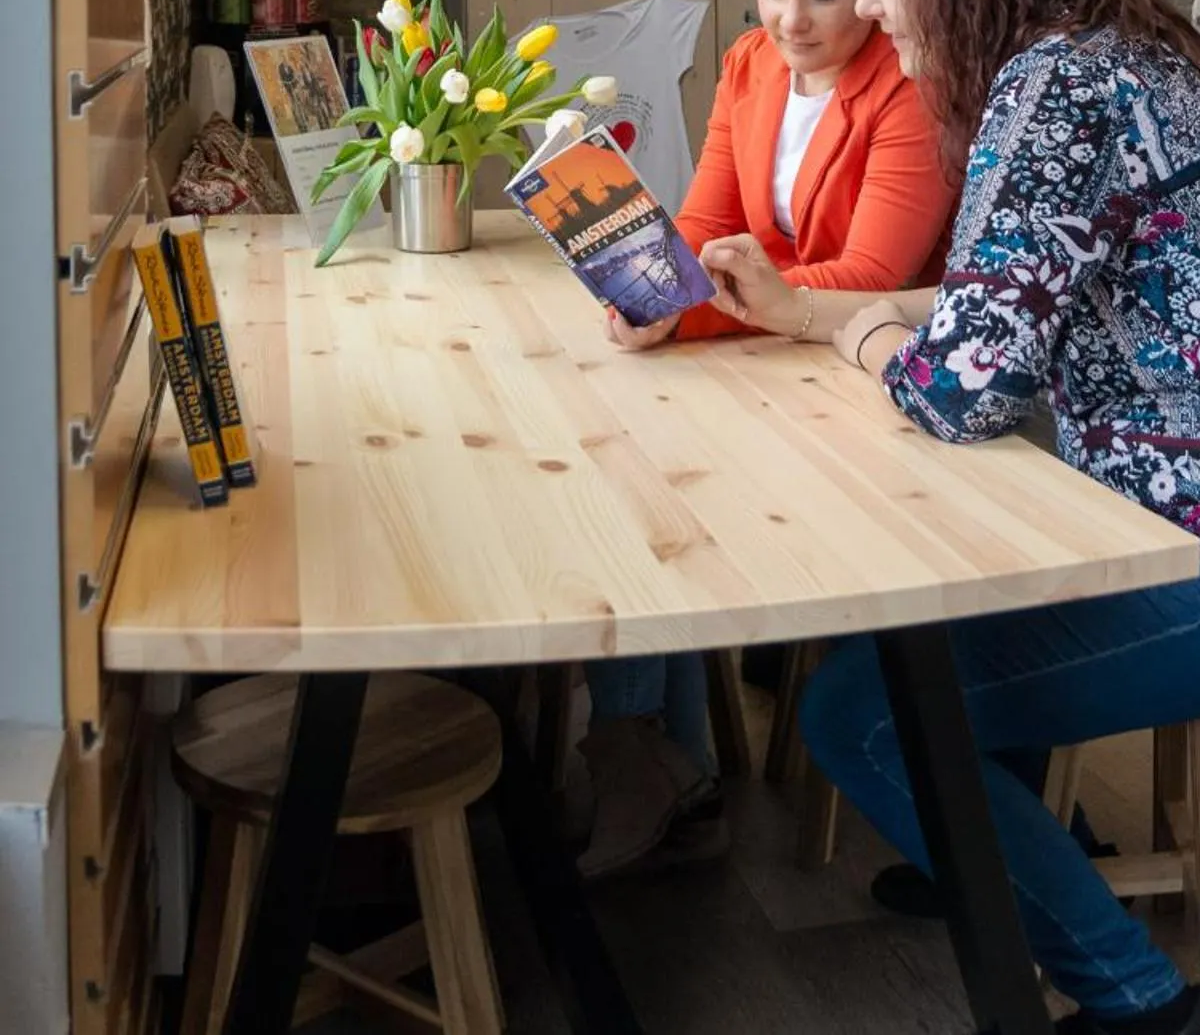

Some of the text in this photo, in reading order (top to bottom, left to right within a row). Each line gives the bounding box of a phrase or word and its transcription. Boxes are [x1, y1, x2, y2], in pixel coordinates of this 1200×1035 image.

[528, 215, 576, 268] AMSTERDAM
[567, 196, 654, 254] AMSTERDAM
[581, 238, 608, 258] CITY
[173, 343, 210, 439] AMSTERDAM
[206, 327, 241, 422] AMSTERDAM
